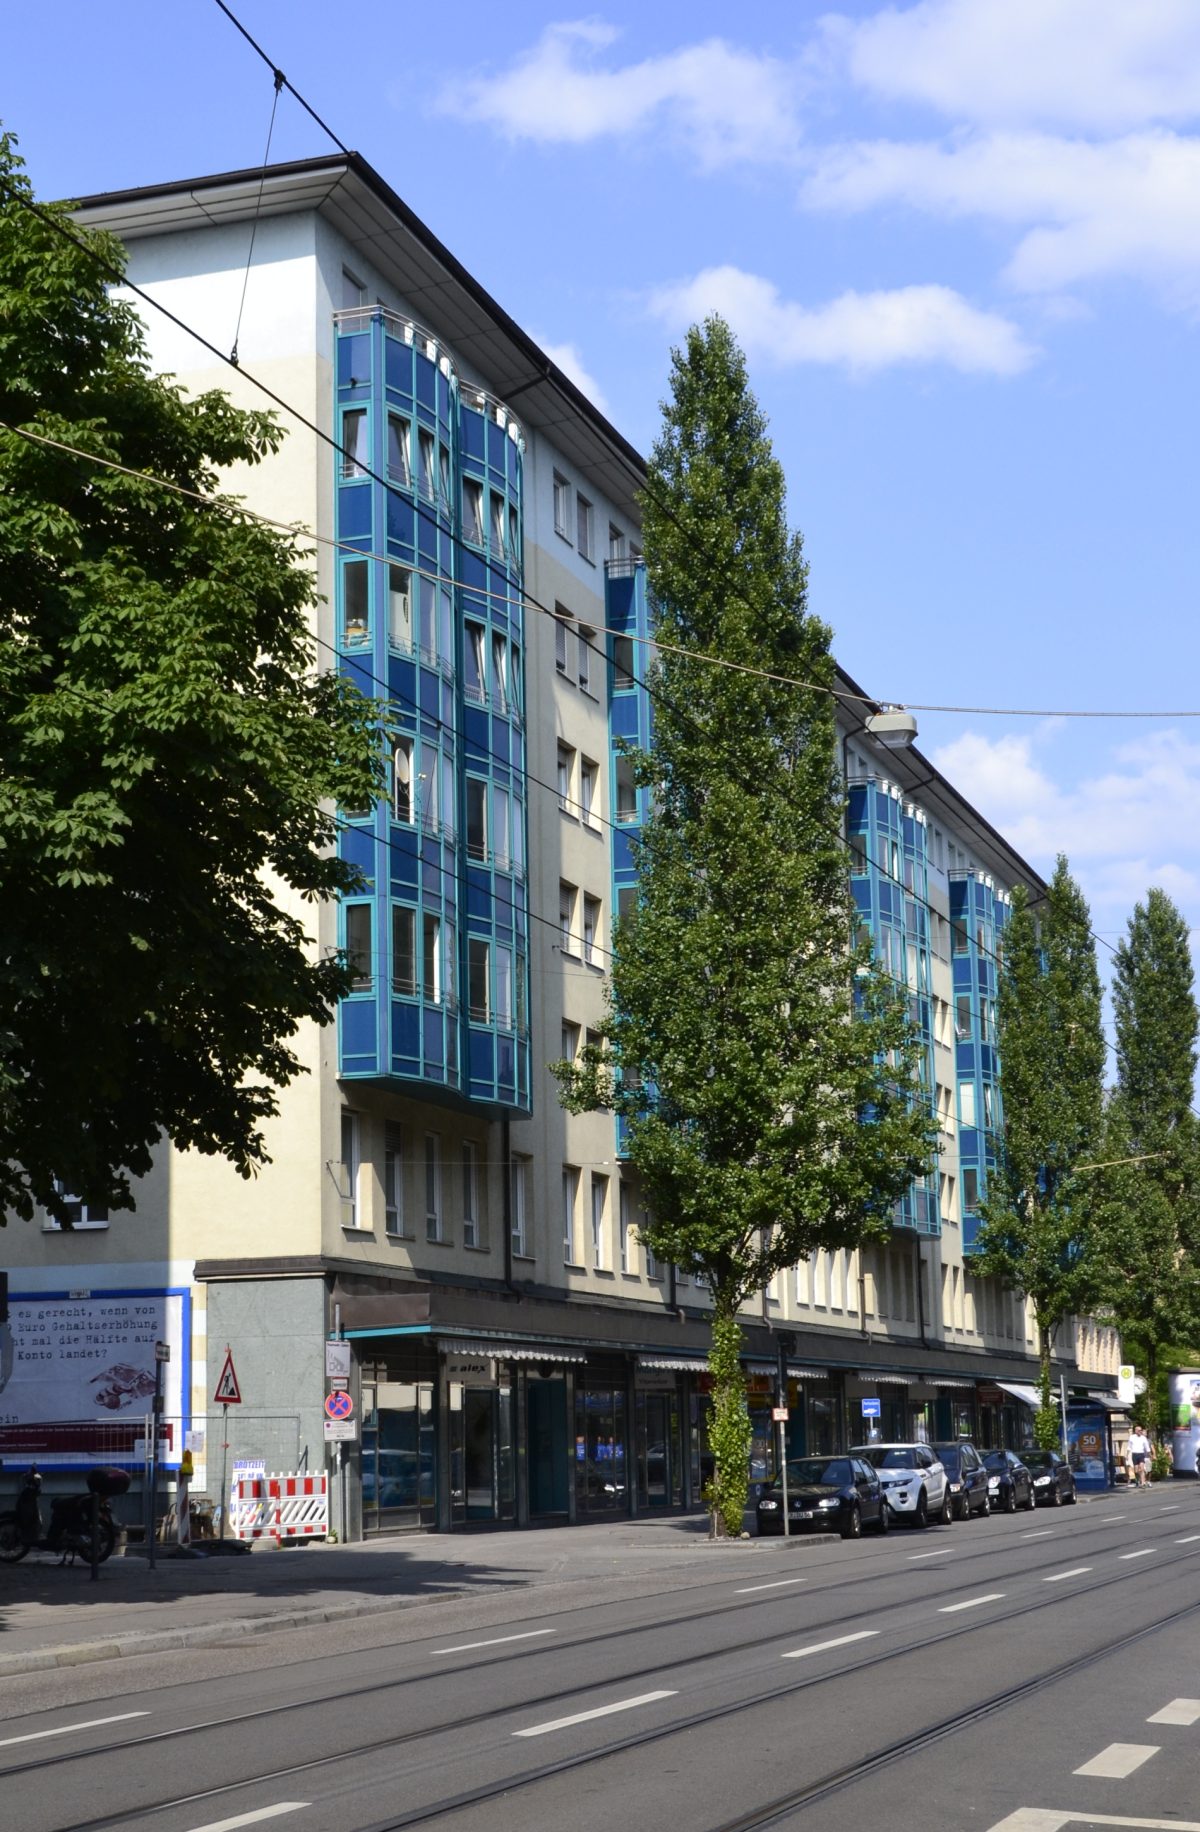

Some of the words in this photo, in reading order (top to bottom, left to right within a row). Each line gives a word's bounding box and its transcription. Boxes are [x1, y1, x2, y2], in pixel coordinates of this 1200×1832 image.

[18, 1311, 31, 1319] es
[38, 1307, 93, 1320] gerecht,
[99, 1307, 128, 1316] wenn
[134, 1306, 156, 1314] von
[18, 1323, 46, 1332] Euro
[52, 1320, 159, 1331] Gehaltserhöhung
[32, 1336, 51, 1346] mal
[59, 1335, 80, 1345] die
[86, 1335, 128, 1344] Hälfte
[134, 1334, 156, 1343] auf
[17, 1351, 53, 1361] Konto
[59, 1349, 108, 1359] landet?
[460, 1363, 486, 1374] alex
[1083, 1435, 1096, 1445] 50
[233, 1460, 266, 1469] BROTZEIT
